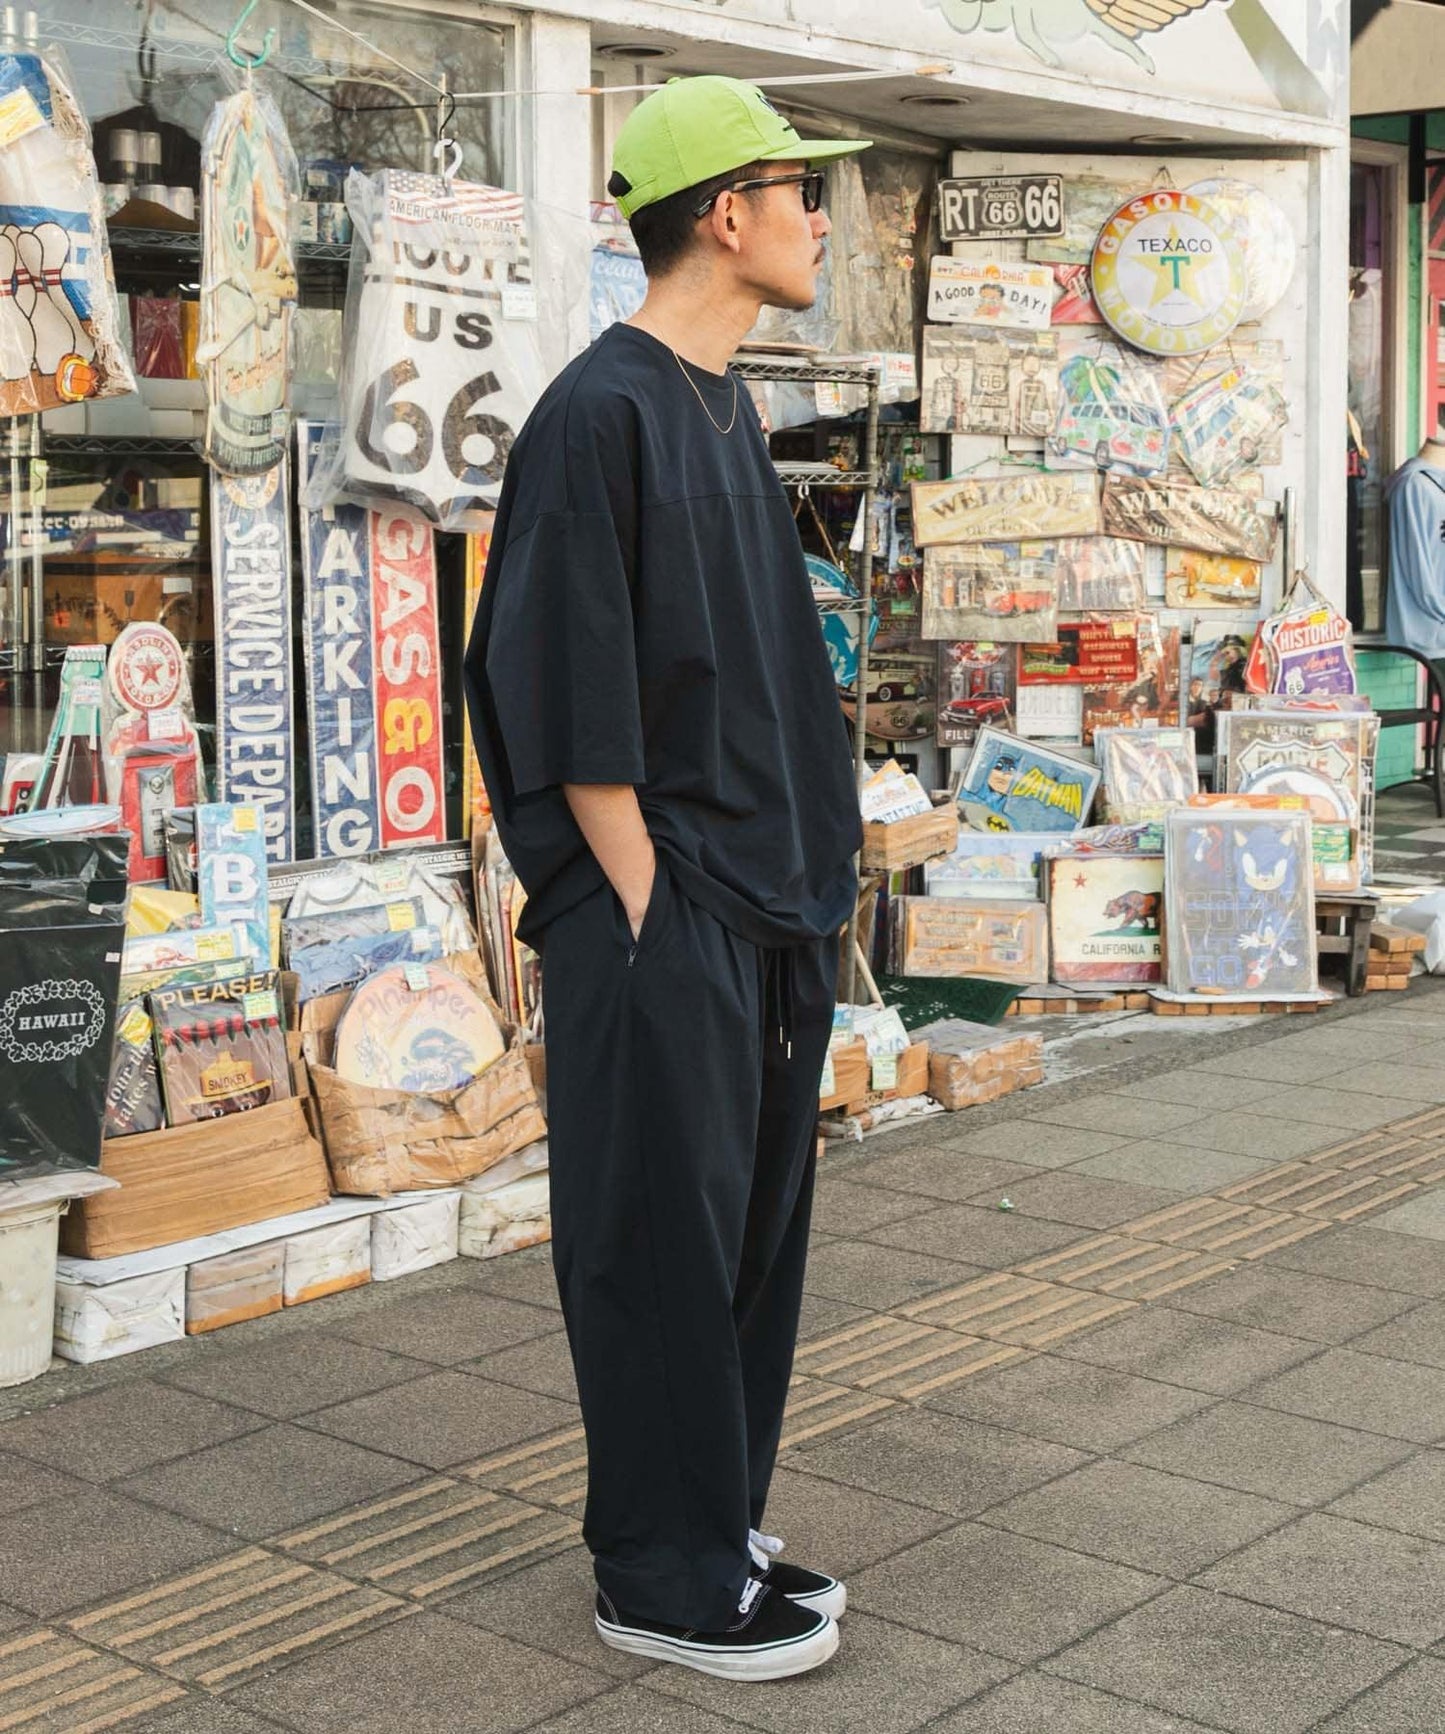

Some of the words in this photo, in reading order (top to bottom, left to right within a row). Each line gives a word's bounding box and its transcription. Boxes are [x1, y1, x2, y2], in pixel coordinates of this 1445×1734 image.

[944, 188, 979, 231] RT
[987, 192, 1016, 200] ROUTE
[989, 201, 1016, 223] 66
[1024, 185, 1059, 228] 66
[390, 200, 448, 222] AMERICAN
[493, 220, 521, 235] MAT
[1137, 238, 1213, 253] TEXACO
[945, 286, 975, 300] GOOD
[1010, 290, 1047, 315] DAY!
[404, 302, 493, 350] US
[355, 358, 515, 486] 66
[224, 521, 285, 695] SERVICE
[376, 511, 431, 686] GAS
[1280, 619, 1345, 651] HISTORIC
[1289, 682, 1303, 694] 66
[945, 729, 971, 740] FILL
[1012, 766, 1083, 819] BATMAN
[1082, 943, 1146, 956] CALIFORNIA
[157, 971, 277, 1011] PLEASE!
[18, 1012, 85, 1031] HAWAII
[208, 1073, 248, 1091] SMOKEY
